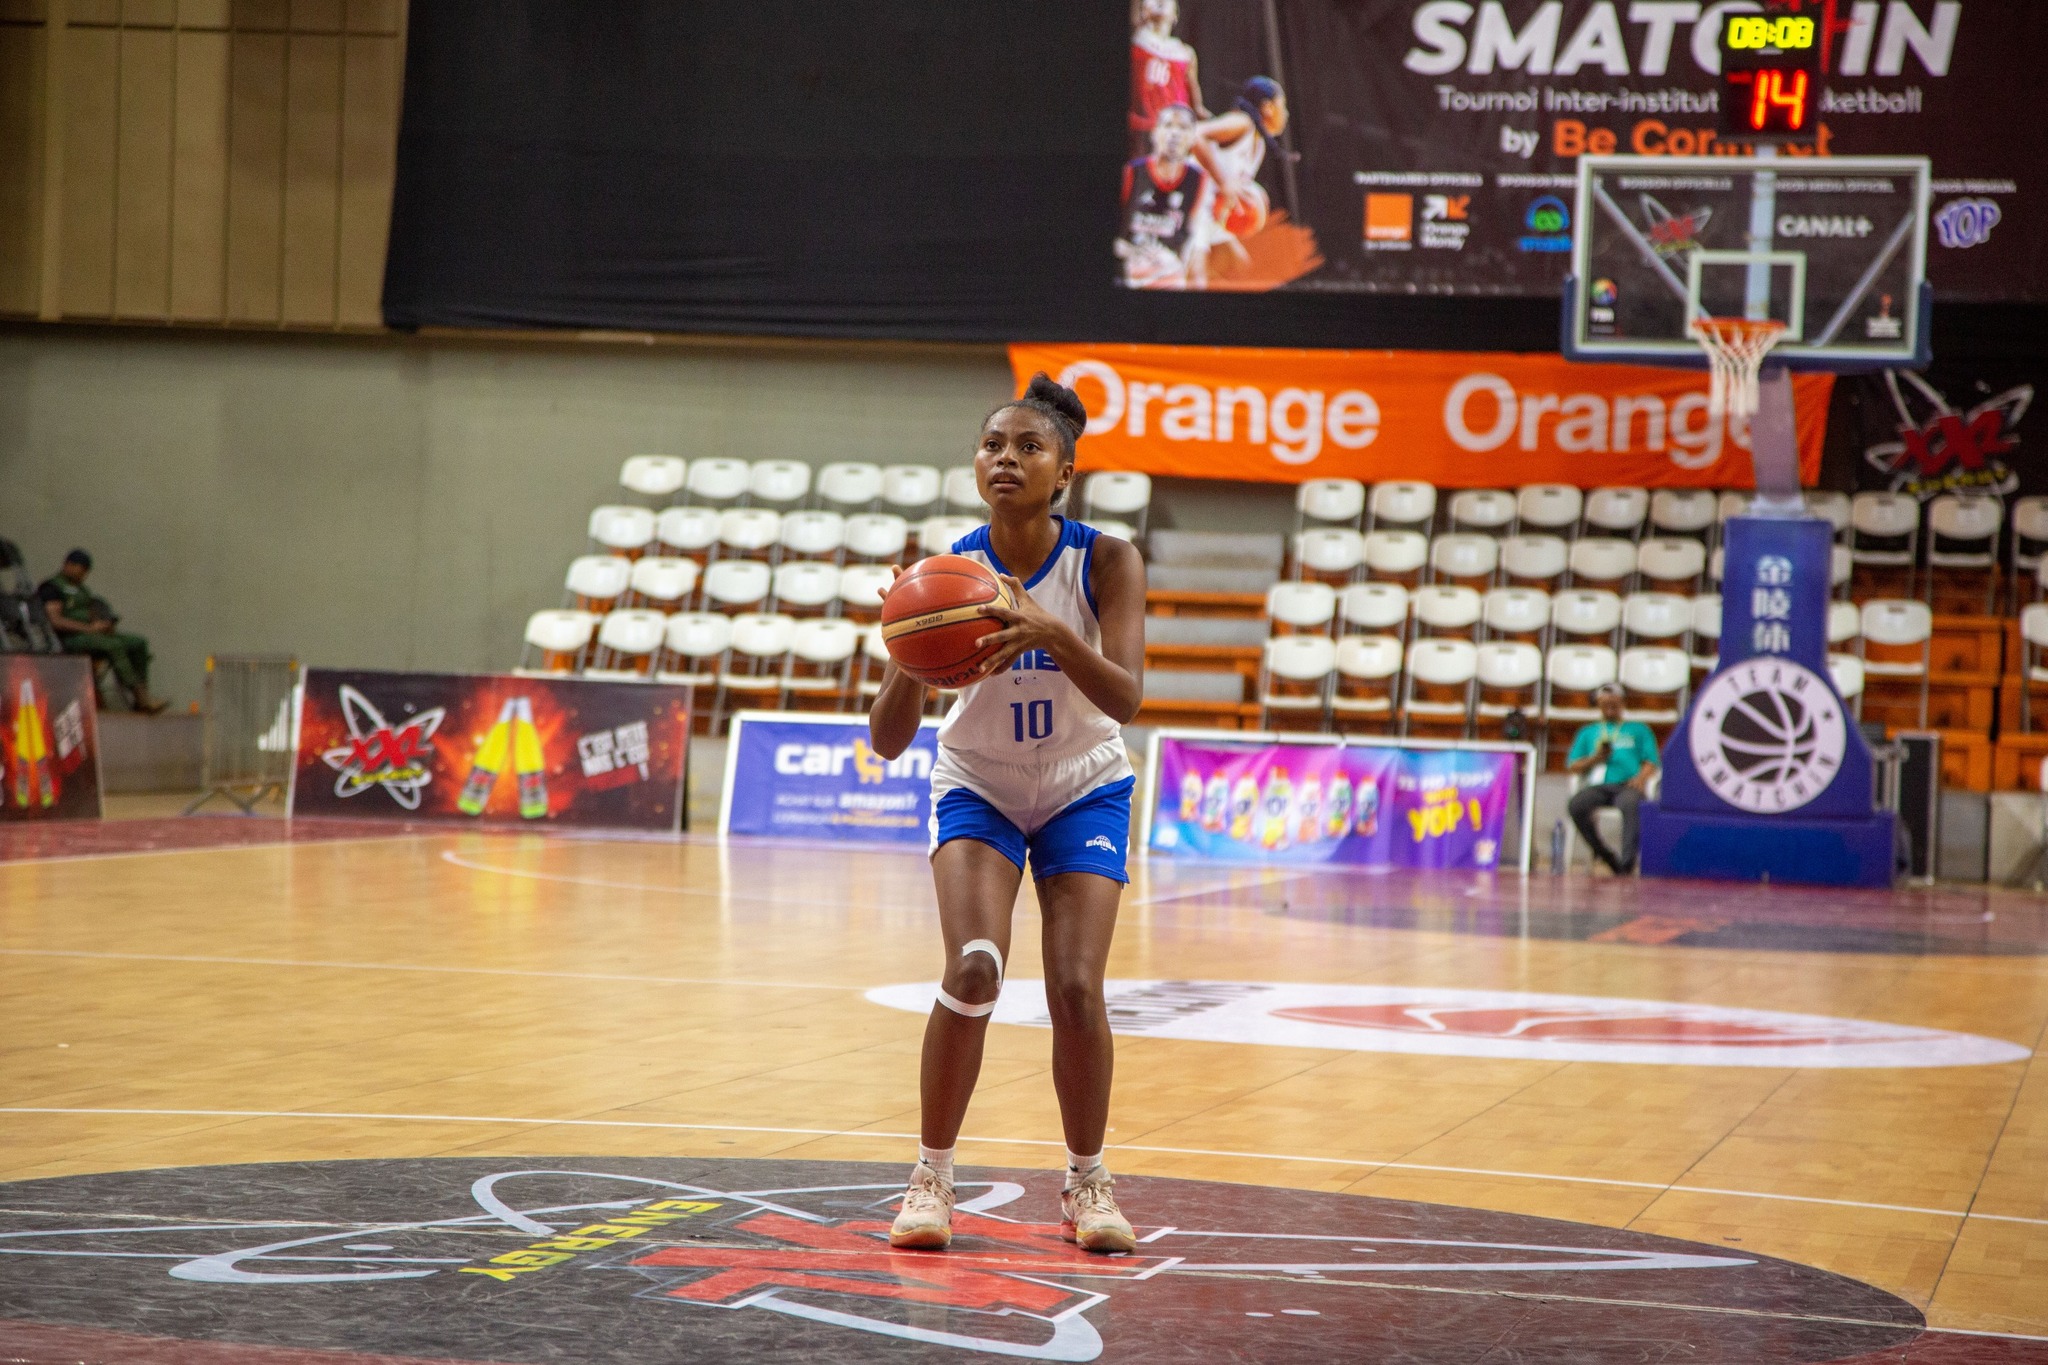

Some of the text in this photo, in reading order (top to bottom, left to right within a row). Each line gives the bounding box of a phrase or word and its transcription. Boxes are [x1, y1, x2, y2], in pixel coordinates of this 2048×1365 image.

[1436, 84, 1539, 112] Tournoi
[1500, 125, 1540, 159] by
[1553, 119, 1617, 157] Be
[1777, 213, 1874, 238] CANAL+
[1934, 197, 2002, 248] YOP
[1056, 359, 1381, 465] Orange
[1444, 372, 1755, 470] Orang
[1010, 699, 1053, 742] 10
[1407, 800, 1464, 842] YOP
[458, 1200, 723, 1281] ENERGY
